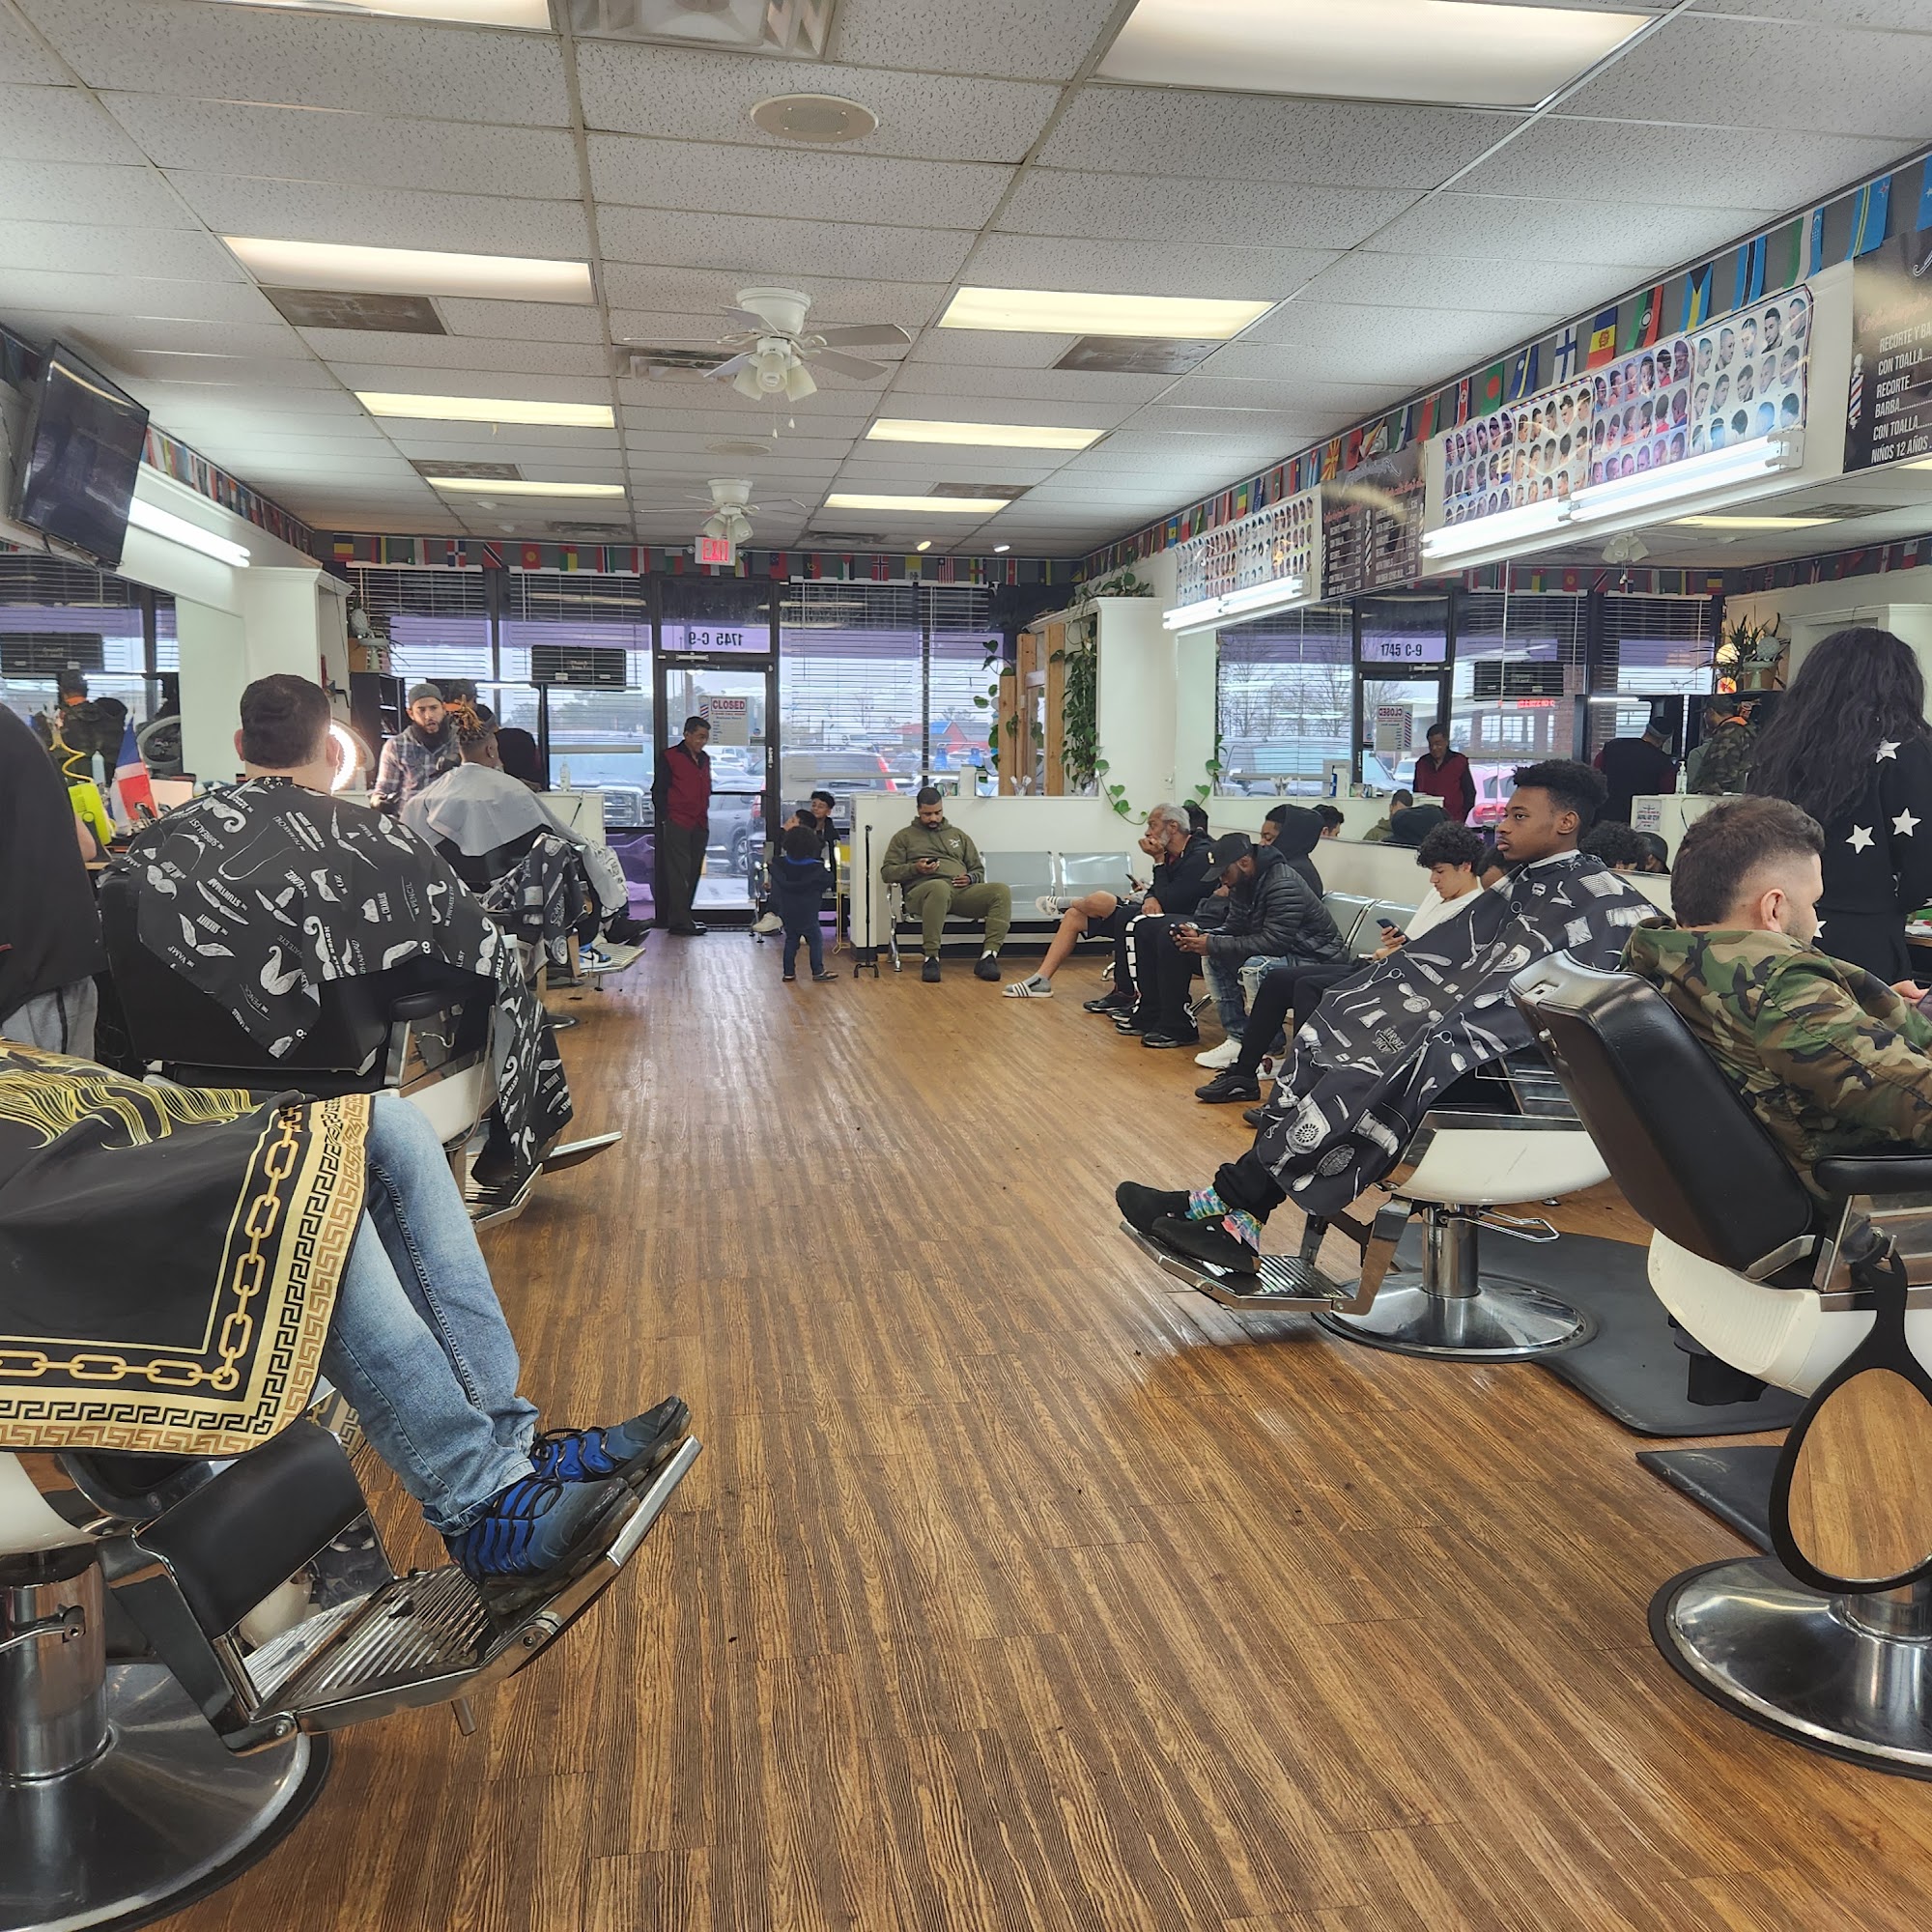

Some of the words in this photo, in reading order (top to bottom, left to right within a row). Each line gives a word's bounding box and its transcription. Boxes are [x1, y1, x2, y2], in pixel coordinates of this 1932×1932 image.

[1879, 328, 1914, 354] RECORTE
[1914, 326, 1919, 340] Y
[1878, 356, 1893, 376] CON
[1894, 348, 1923, 370] TOALLA
[1876, 375, 1911, 399] RECORTE
[1874, 397, 1900, 418] BARBA
[1873, 422, 1889, 441] CON
[1889, 414, 1918, 437] TOALLA
[1896, 440, 1906, 457] 12
[1906, 435, 1929, 455] AÑOS
[702, 538, 729, 561] EXIT
[1380, 643, 1402, 657] 1745
[1406, 643, 1423, 657] C-9
[712, 699, 745, 710] CLOSED
[188, 818, 219, 847] SURREALIST
[207, 877, 242, 908] STUNTMAN
[167, 945, 186, 965] VAMP
